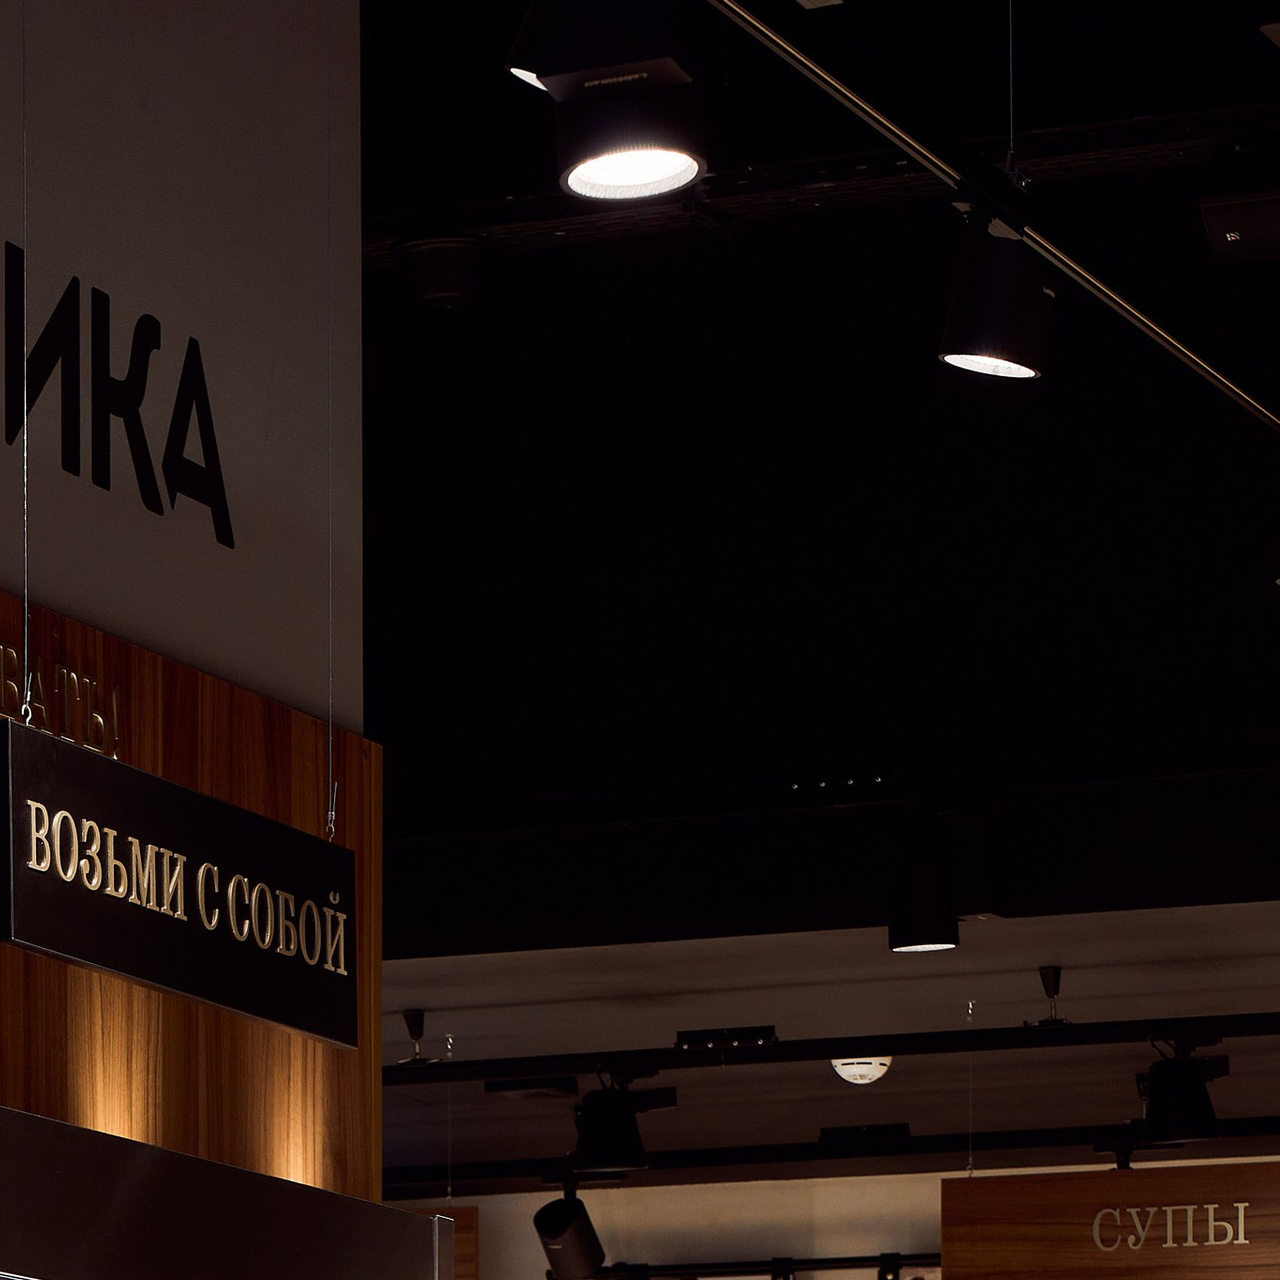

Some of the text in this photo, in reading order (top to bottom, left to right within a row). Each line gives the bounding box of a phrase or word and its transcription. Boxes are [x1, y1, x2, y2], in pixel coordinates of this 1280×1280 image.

[26, 799, 348, 976] ВОЗЬМИ С СОБОЙ
[1092, 1202, 1250, 1251] СУПЫ
